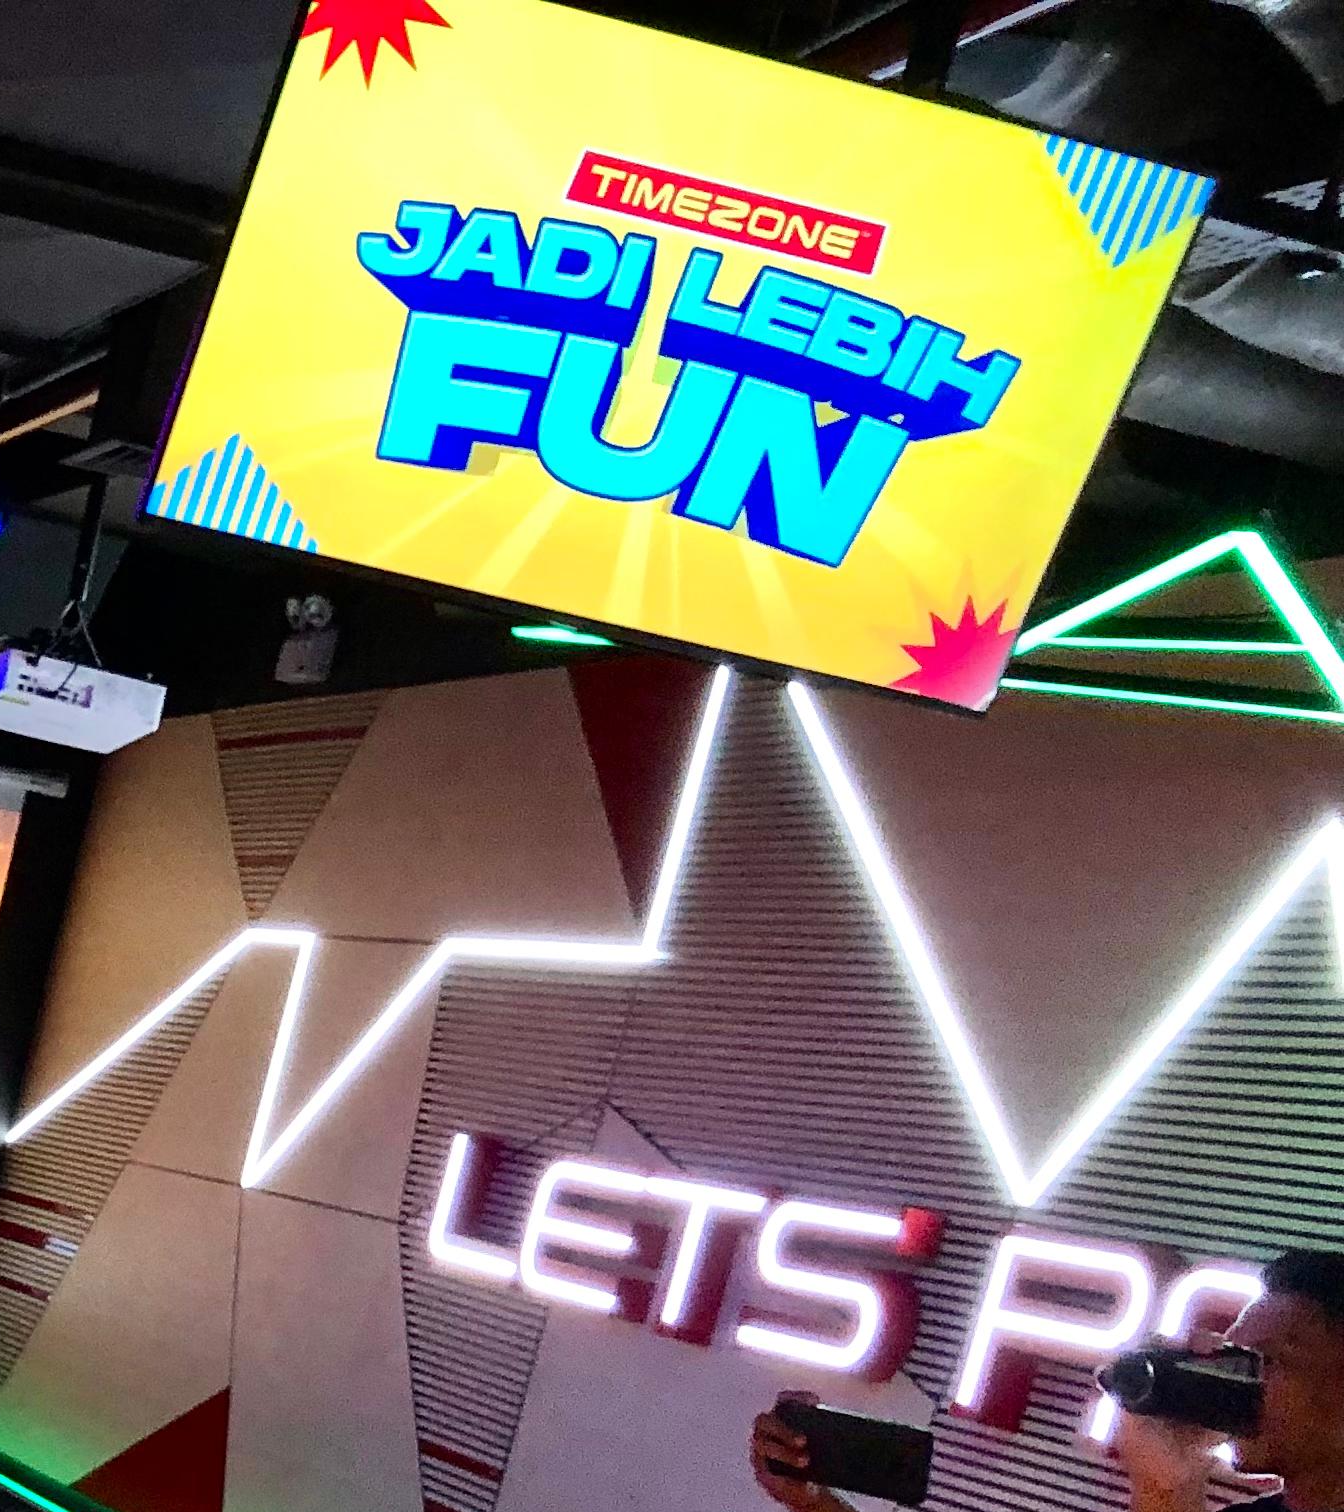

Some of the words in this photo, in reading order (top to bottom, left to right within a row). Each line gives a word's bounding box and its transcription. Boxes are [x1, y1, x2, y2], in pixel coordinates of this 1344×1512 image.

[356, 200, 657, 312] JADI
[666, 246, 1022, 429] LEBIH
[590, 164, 860, 259] TIMEZONE
[376, 308, 910, 568] FUN
[424, 1130, 902, 1378] LETS
